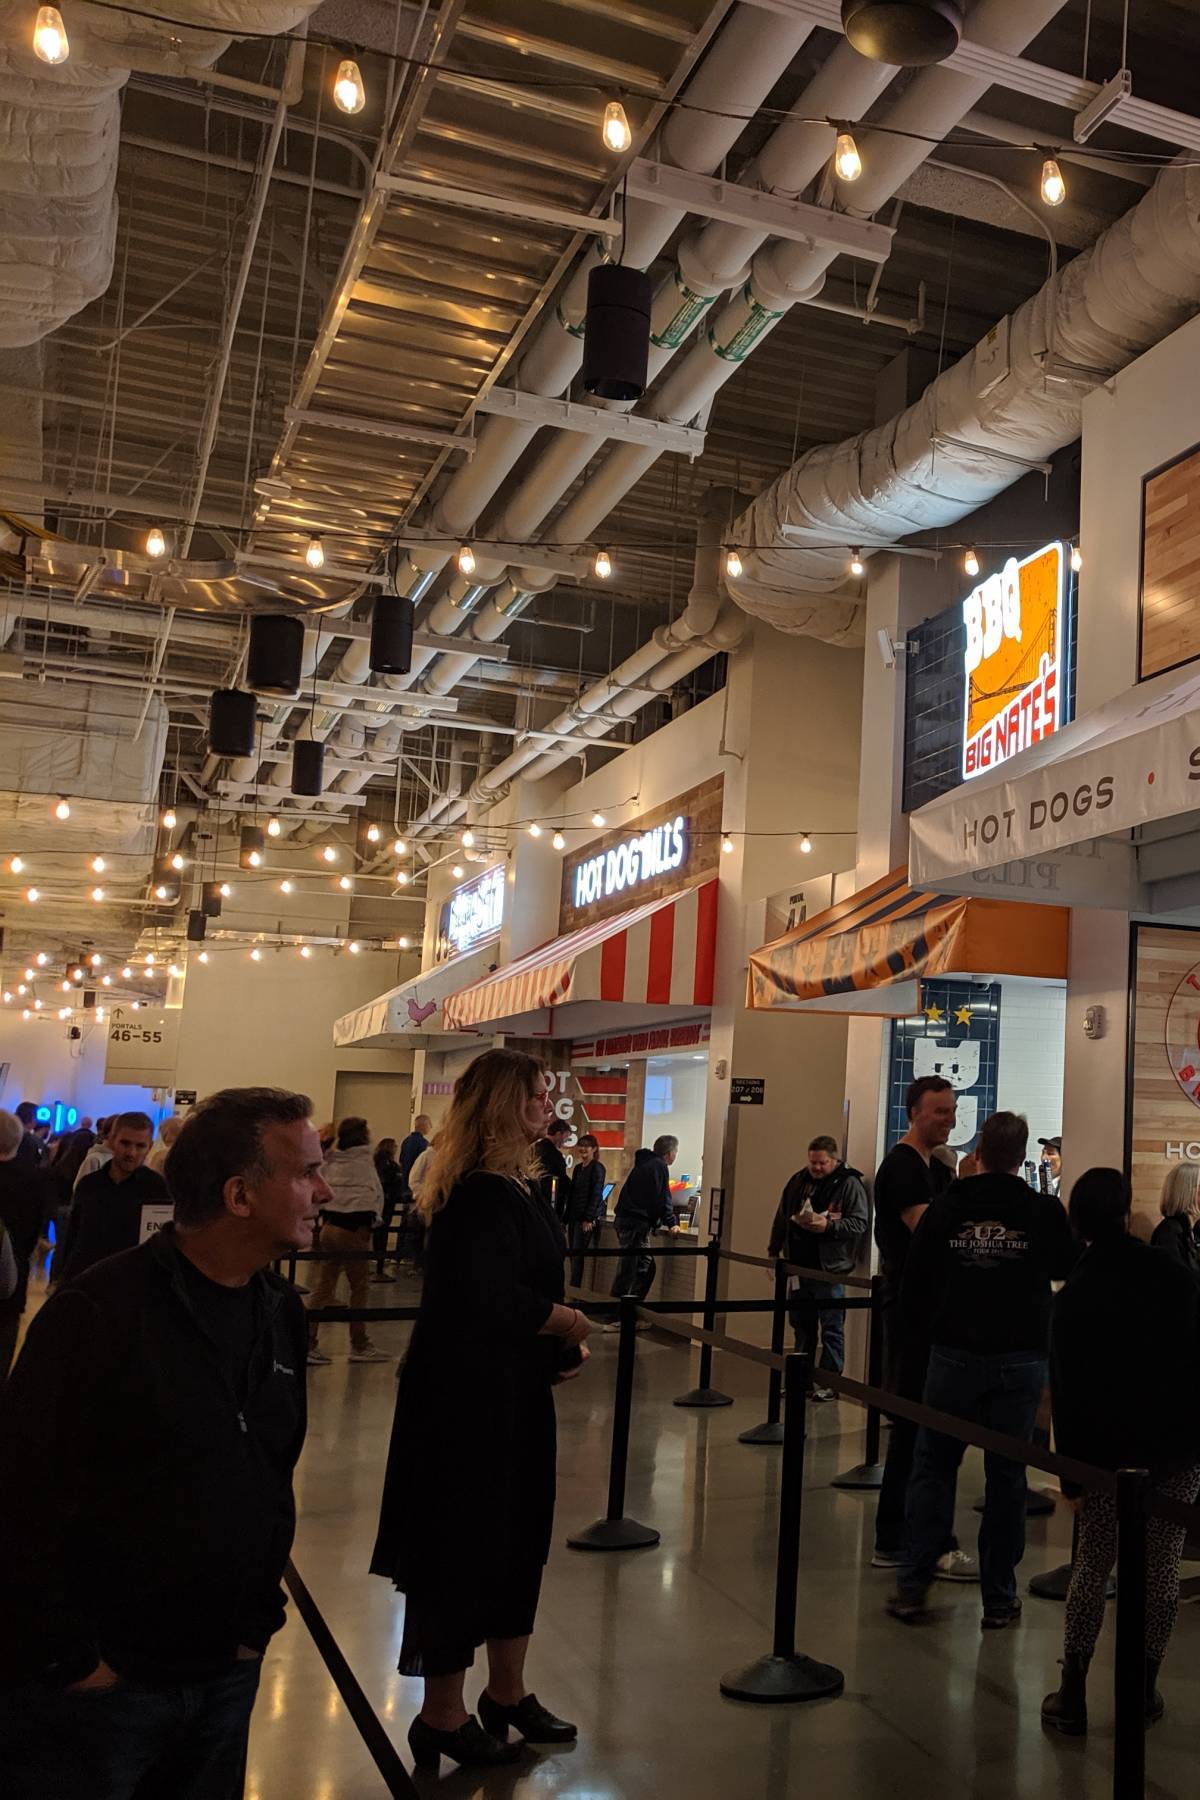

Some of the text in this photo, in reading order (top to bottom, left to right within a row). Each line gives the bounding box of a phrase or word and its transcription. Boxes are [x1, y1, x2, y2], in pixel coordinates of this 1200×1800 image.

[963, 557, 1022, 674] BBQ
[965, 658, 1056, 774] BIG NATE'S
[964, 808, 1017, 850] HOT
[1030, 776, 1115, 831] DOGS
[575, 854, 606, 908] HOT
[606, 838, 640, 895] DOG
[545, 1070, 571, 1093] OT
[948, 1240, 1029, 1250] THE JOSHUA TREE
[973, 1225, 1007, 1240] U2
